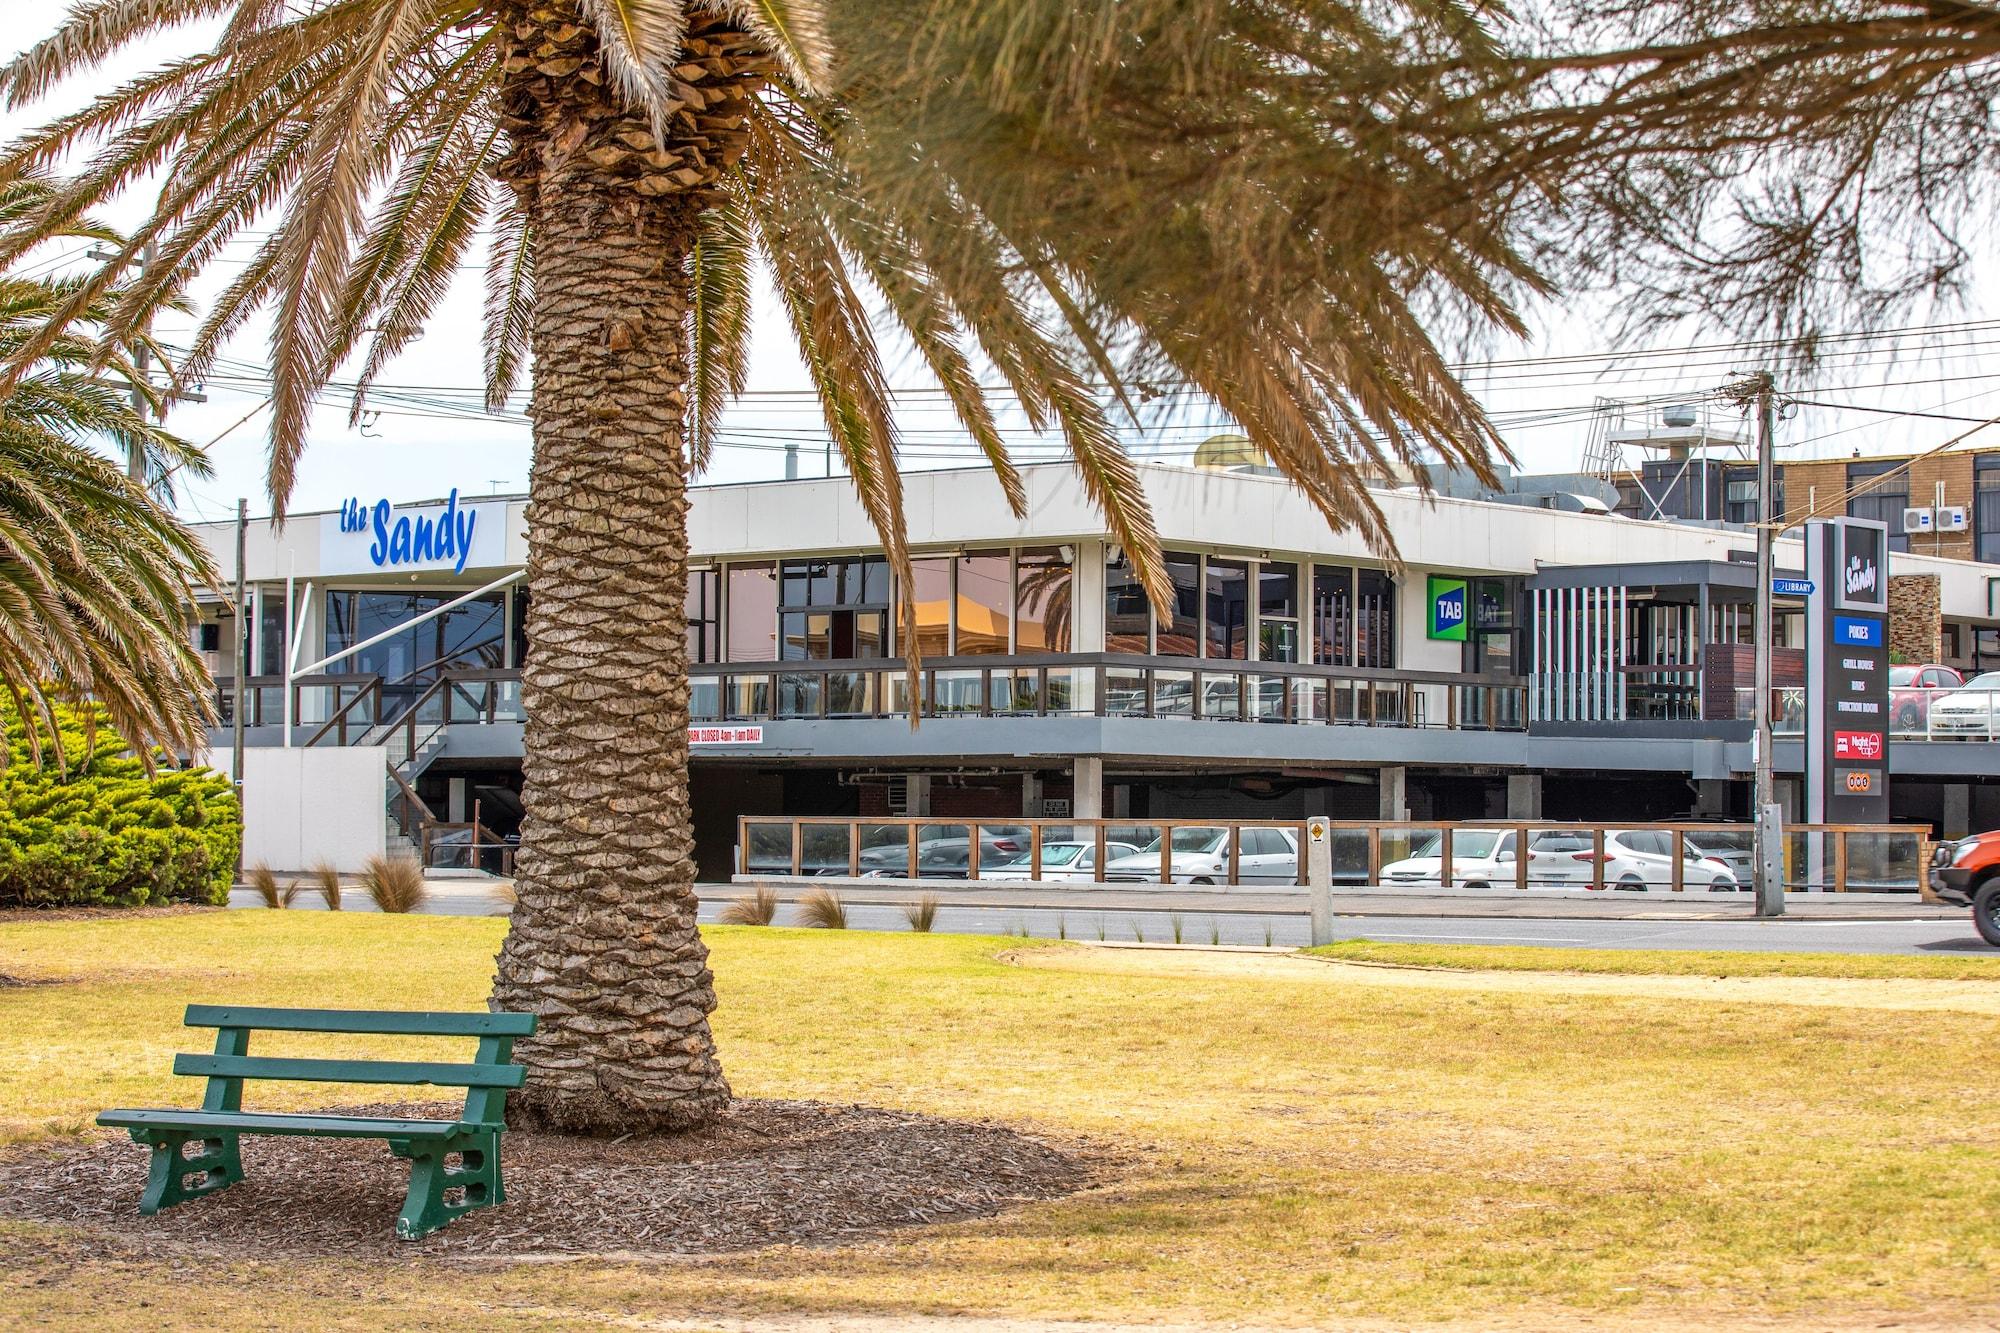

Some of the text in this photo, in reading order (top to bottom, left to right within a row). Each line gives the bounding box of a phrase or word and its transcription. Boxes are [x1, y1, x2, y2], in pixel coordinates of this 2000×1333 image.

[341, 497, 367, 532] the
[370, 488, 476, 576] Sandy
[1852, 555, 1861, 571] the
[1846, 559, 1876, 594] Sandy
[1785, 582, 1811, 592] LIBRARY
[1438, 601, 1462, 619] TAB
[1848, 625, 1868, 639] POKIES
[701, 729, 719, 742] CLOSED
[747, 729, 760, 741] DAILY
[1851, 735, 1869, 751] Night
